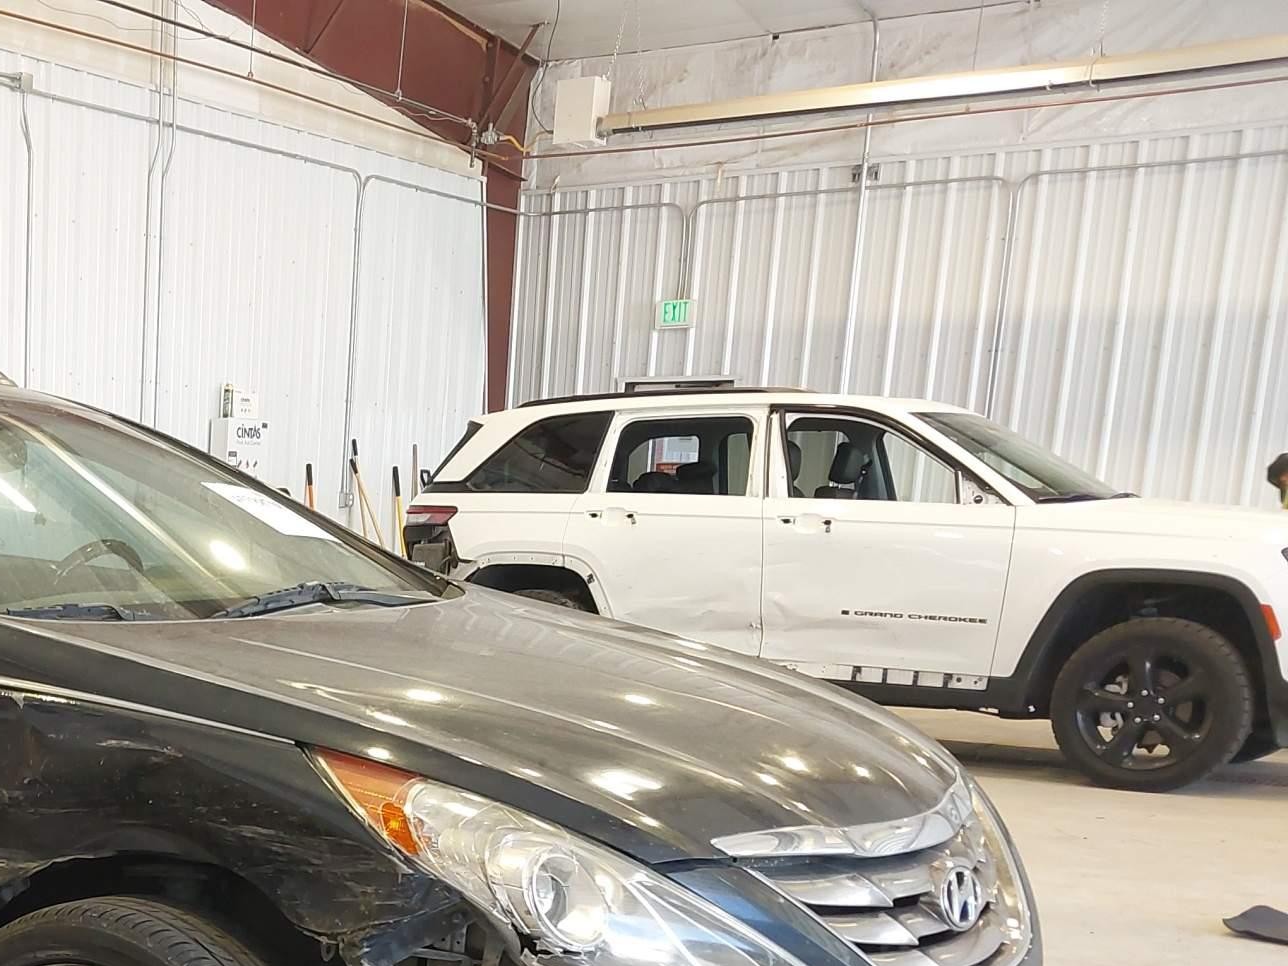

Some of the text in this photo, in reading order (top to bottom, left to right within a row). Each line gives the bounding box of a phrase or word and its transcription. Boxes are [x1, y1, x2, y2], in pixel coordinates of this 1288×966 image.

[663, 301, 689, 323] EXIT
[236, 424, 261, 439] CINTAS
[853, 610, 988, 625] GRAND CHEROKEE
